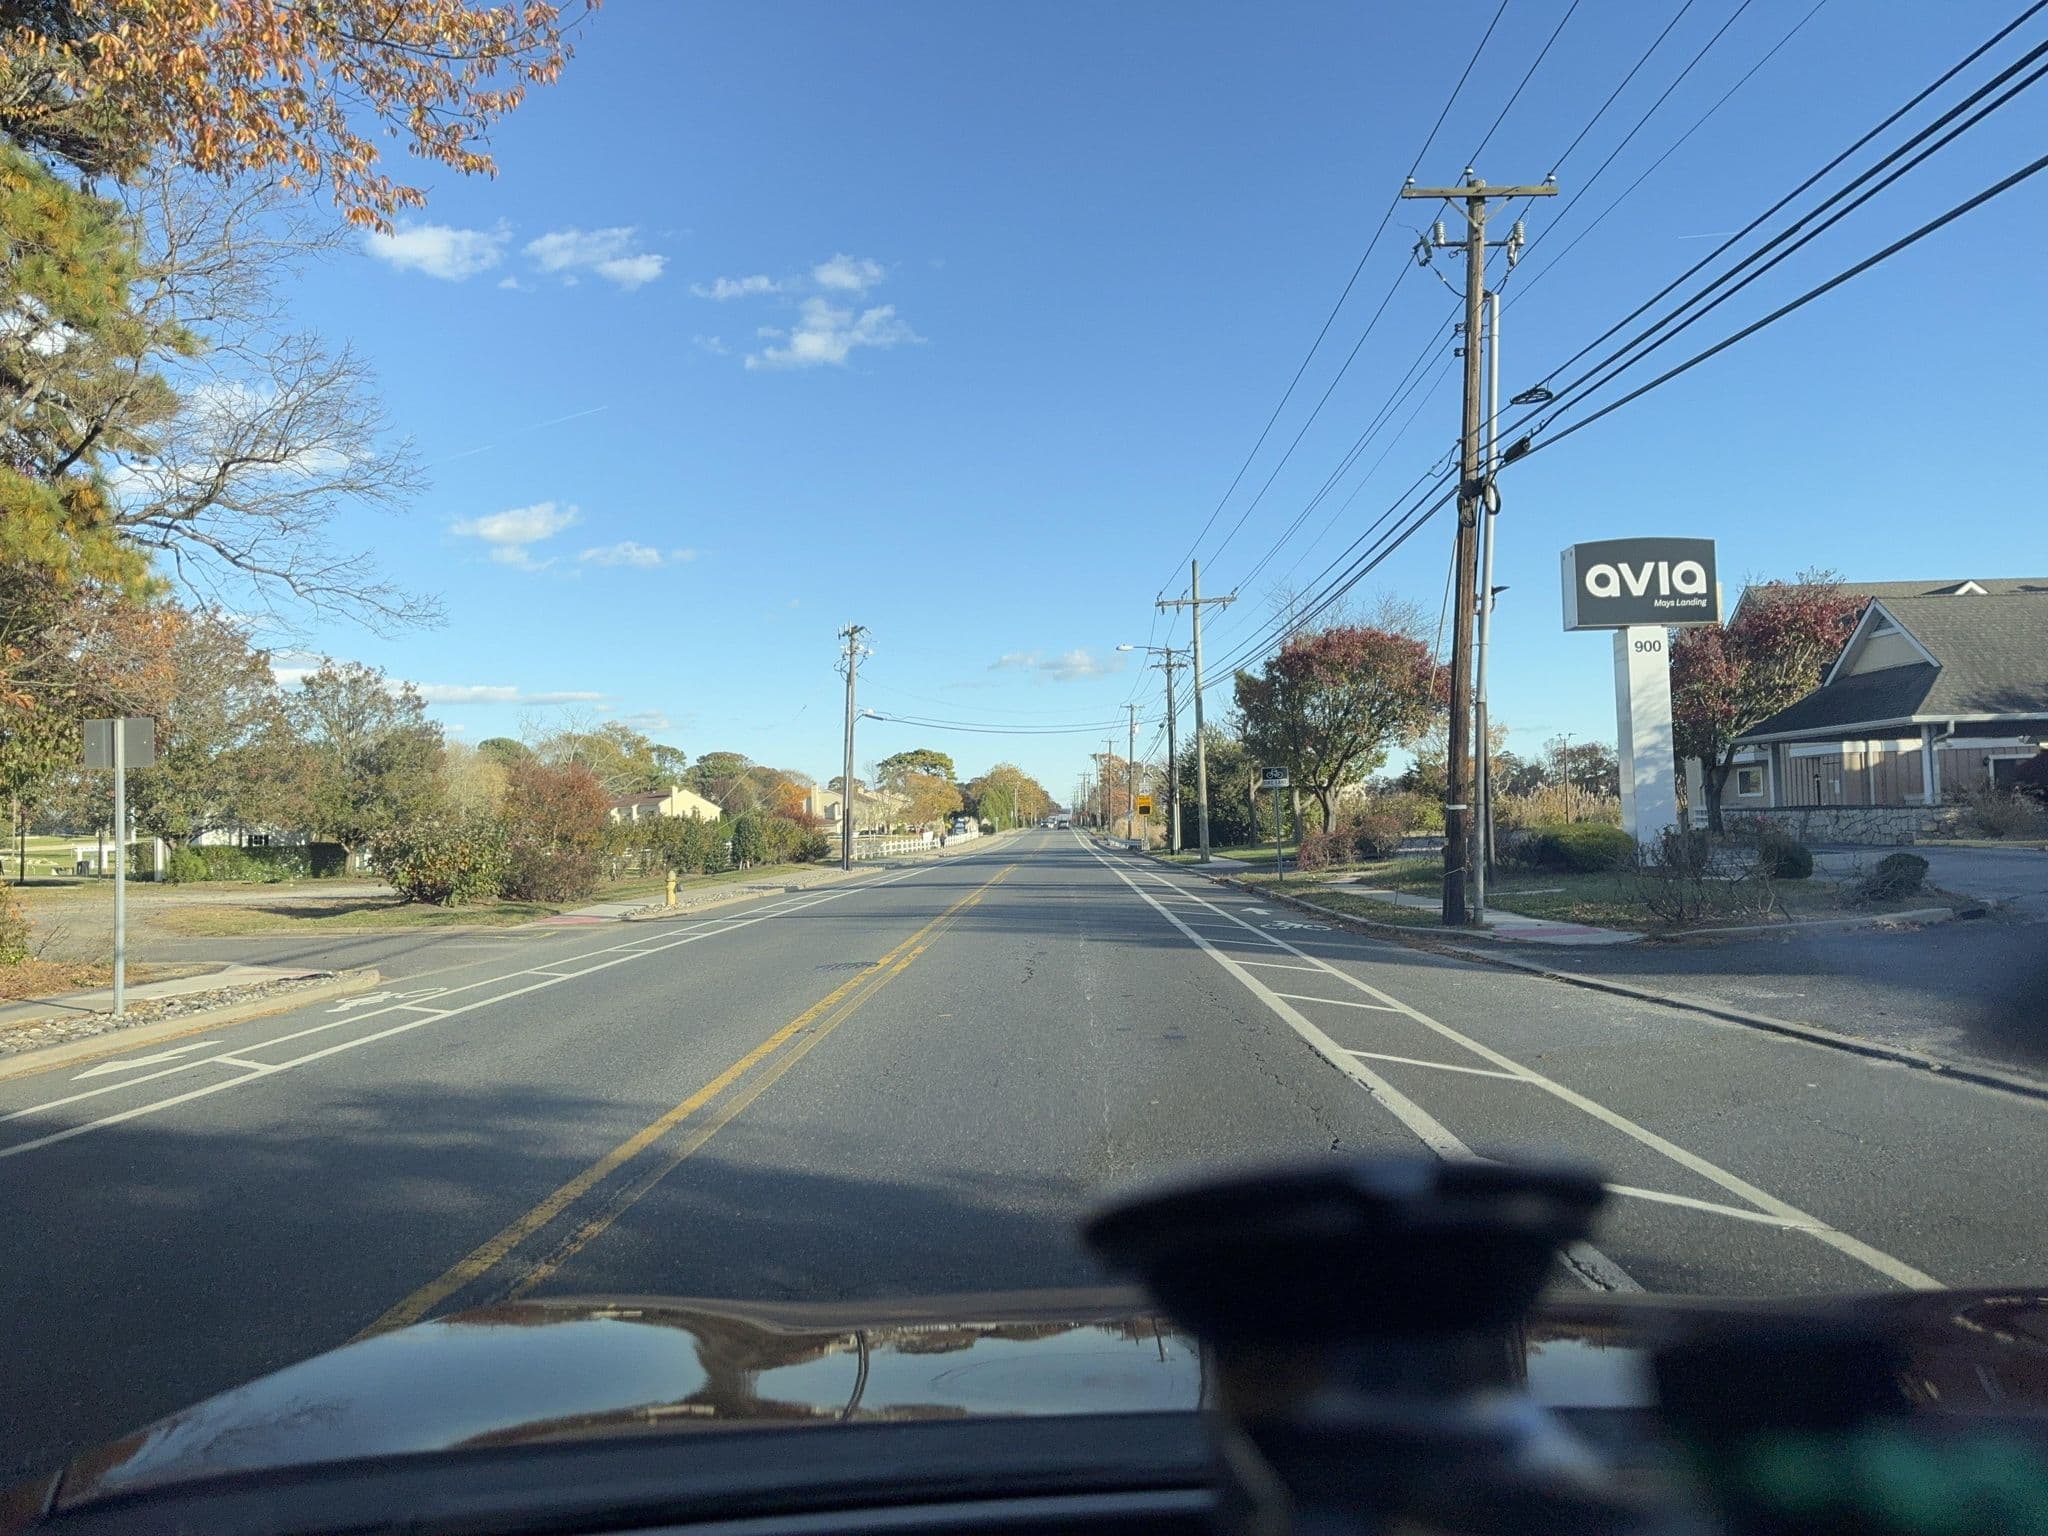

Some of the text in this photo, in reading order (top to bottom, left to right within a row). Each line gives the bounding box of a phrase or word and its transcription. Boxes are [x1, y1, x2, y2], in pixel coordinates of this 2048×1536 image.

[1585, 560, 1707, 597] avia
[1654, 597, 1707, 608] Mays Landing
[1634, 640, 1662, 653] 900
